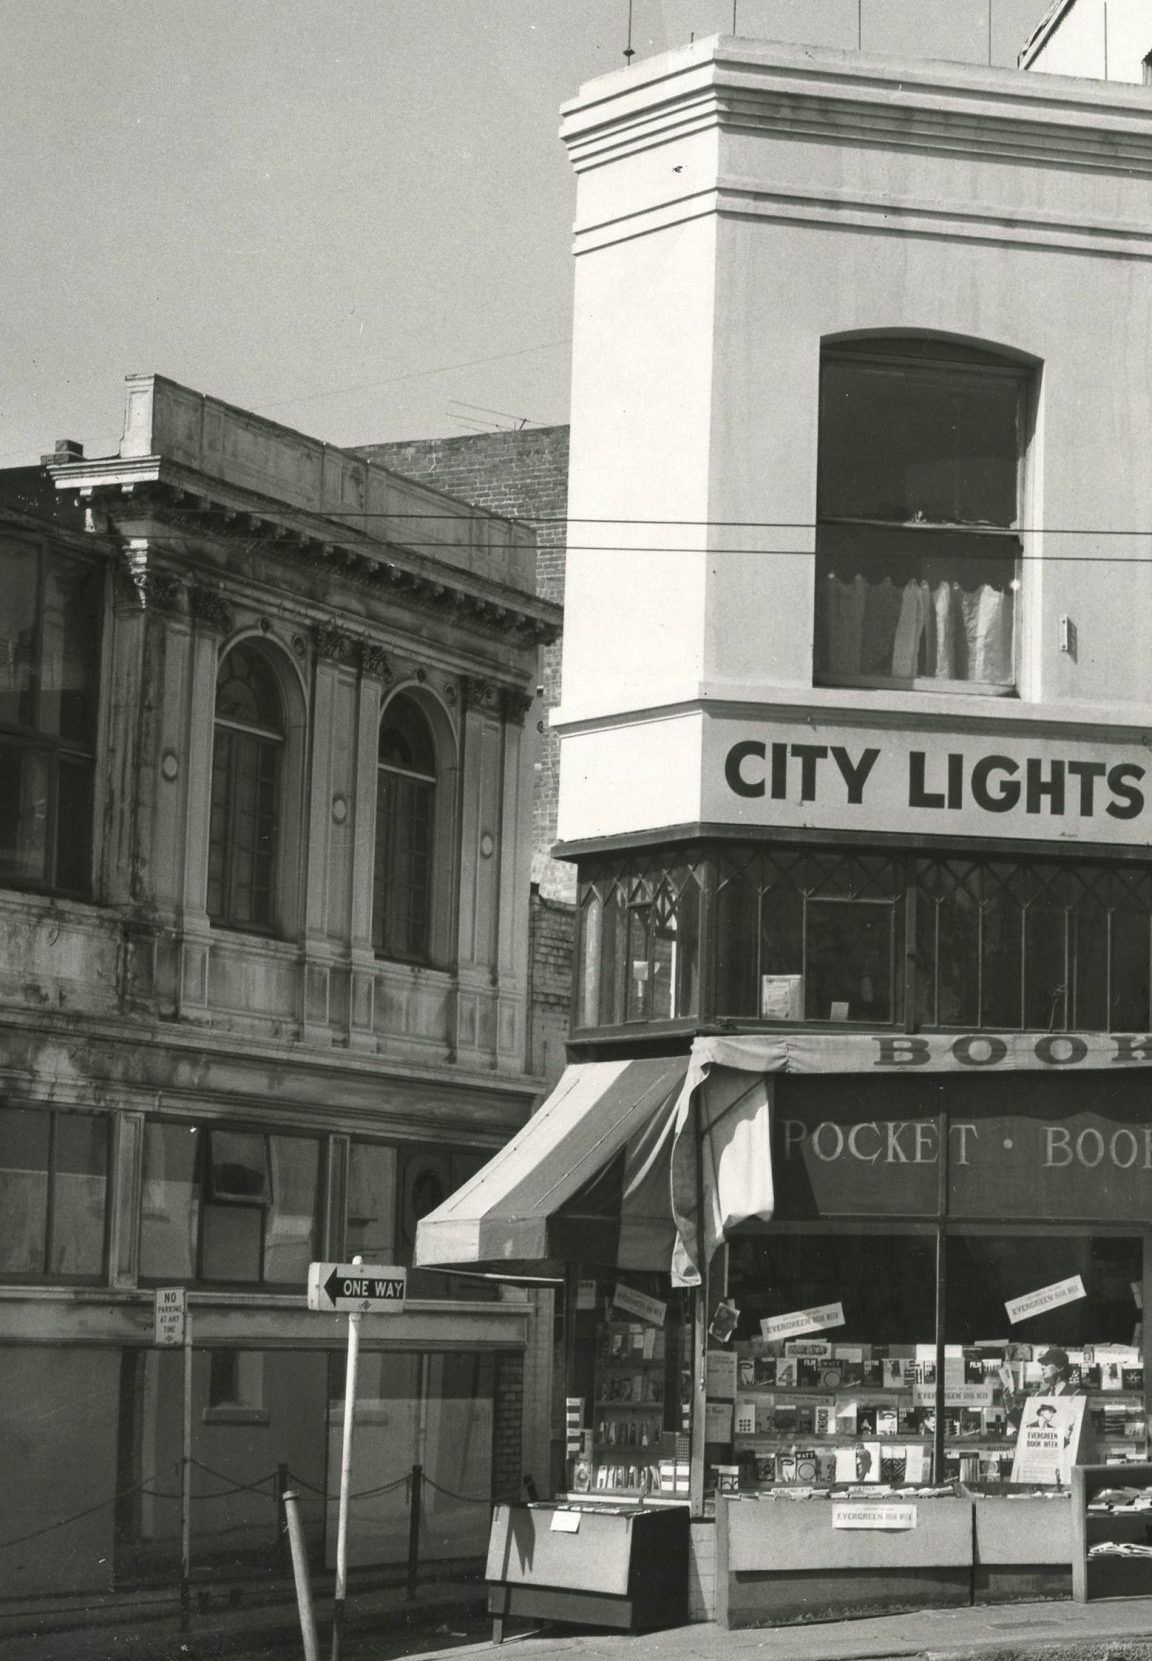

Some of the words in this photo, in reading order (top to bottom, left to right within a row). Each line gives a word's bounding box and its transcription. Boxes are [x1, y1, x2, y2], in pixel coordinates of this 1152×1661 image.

[724, 740, 881, 804] CITY
[908, 750, 1146, 820] LIGHTS
[782, 1119, 979, 1166] POCKET
[343, 1280, 368, 1296] ONE
[374, 1281, 404, 1298] WAY
[164, 1292, 177, 1303] NO
[917, 1390, 961, 1400] EVEREEN
[1027, 1431, 1058, 1440] EVERGREEN
[1026, 1440, 1042, 1448] BOOK
[1043, 1440, 1058, 1448] WEEK
[837, 1512, 883, 1521] EVERGREEN
